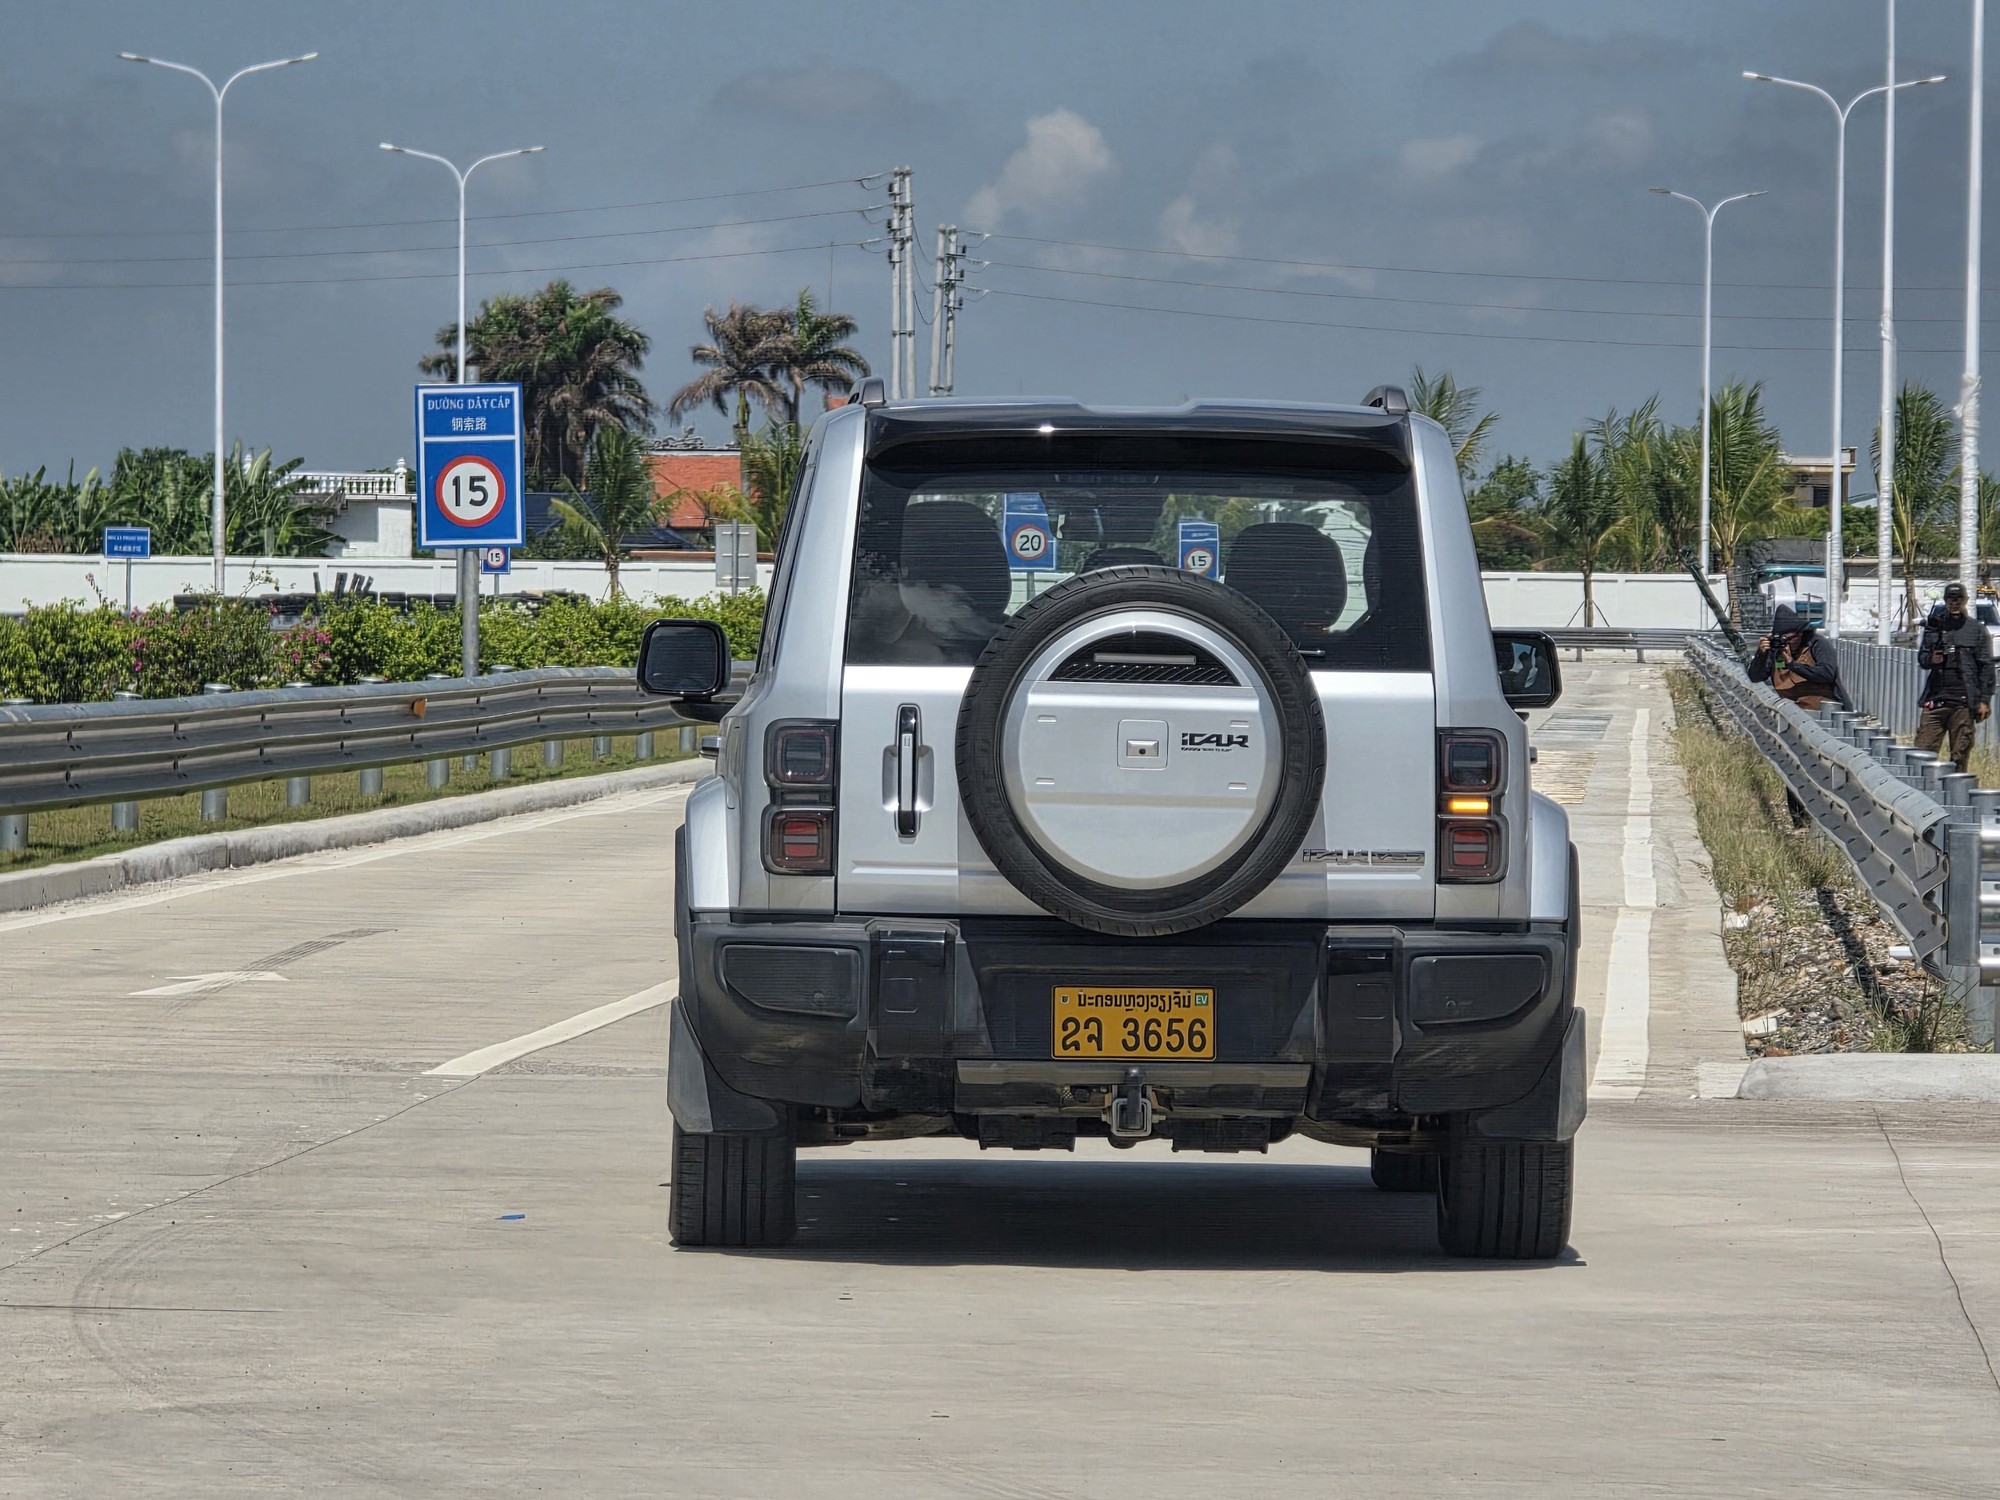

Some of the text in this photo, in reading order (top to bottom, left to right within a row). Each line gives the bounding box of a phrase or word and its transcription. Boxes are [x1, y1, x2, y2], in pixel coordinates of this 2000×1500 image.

[452, 475, 489, 507] 15
[1019, 534, 1042, 551] 20
[490, 552, 501, 562] 15
[1191, 555, 1207, 566] 15
[1195, 994, 1208, 1005] EV
[1121, 1017, 1207, 1053] 3656
